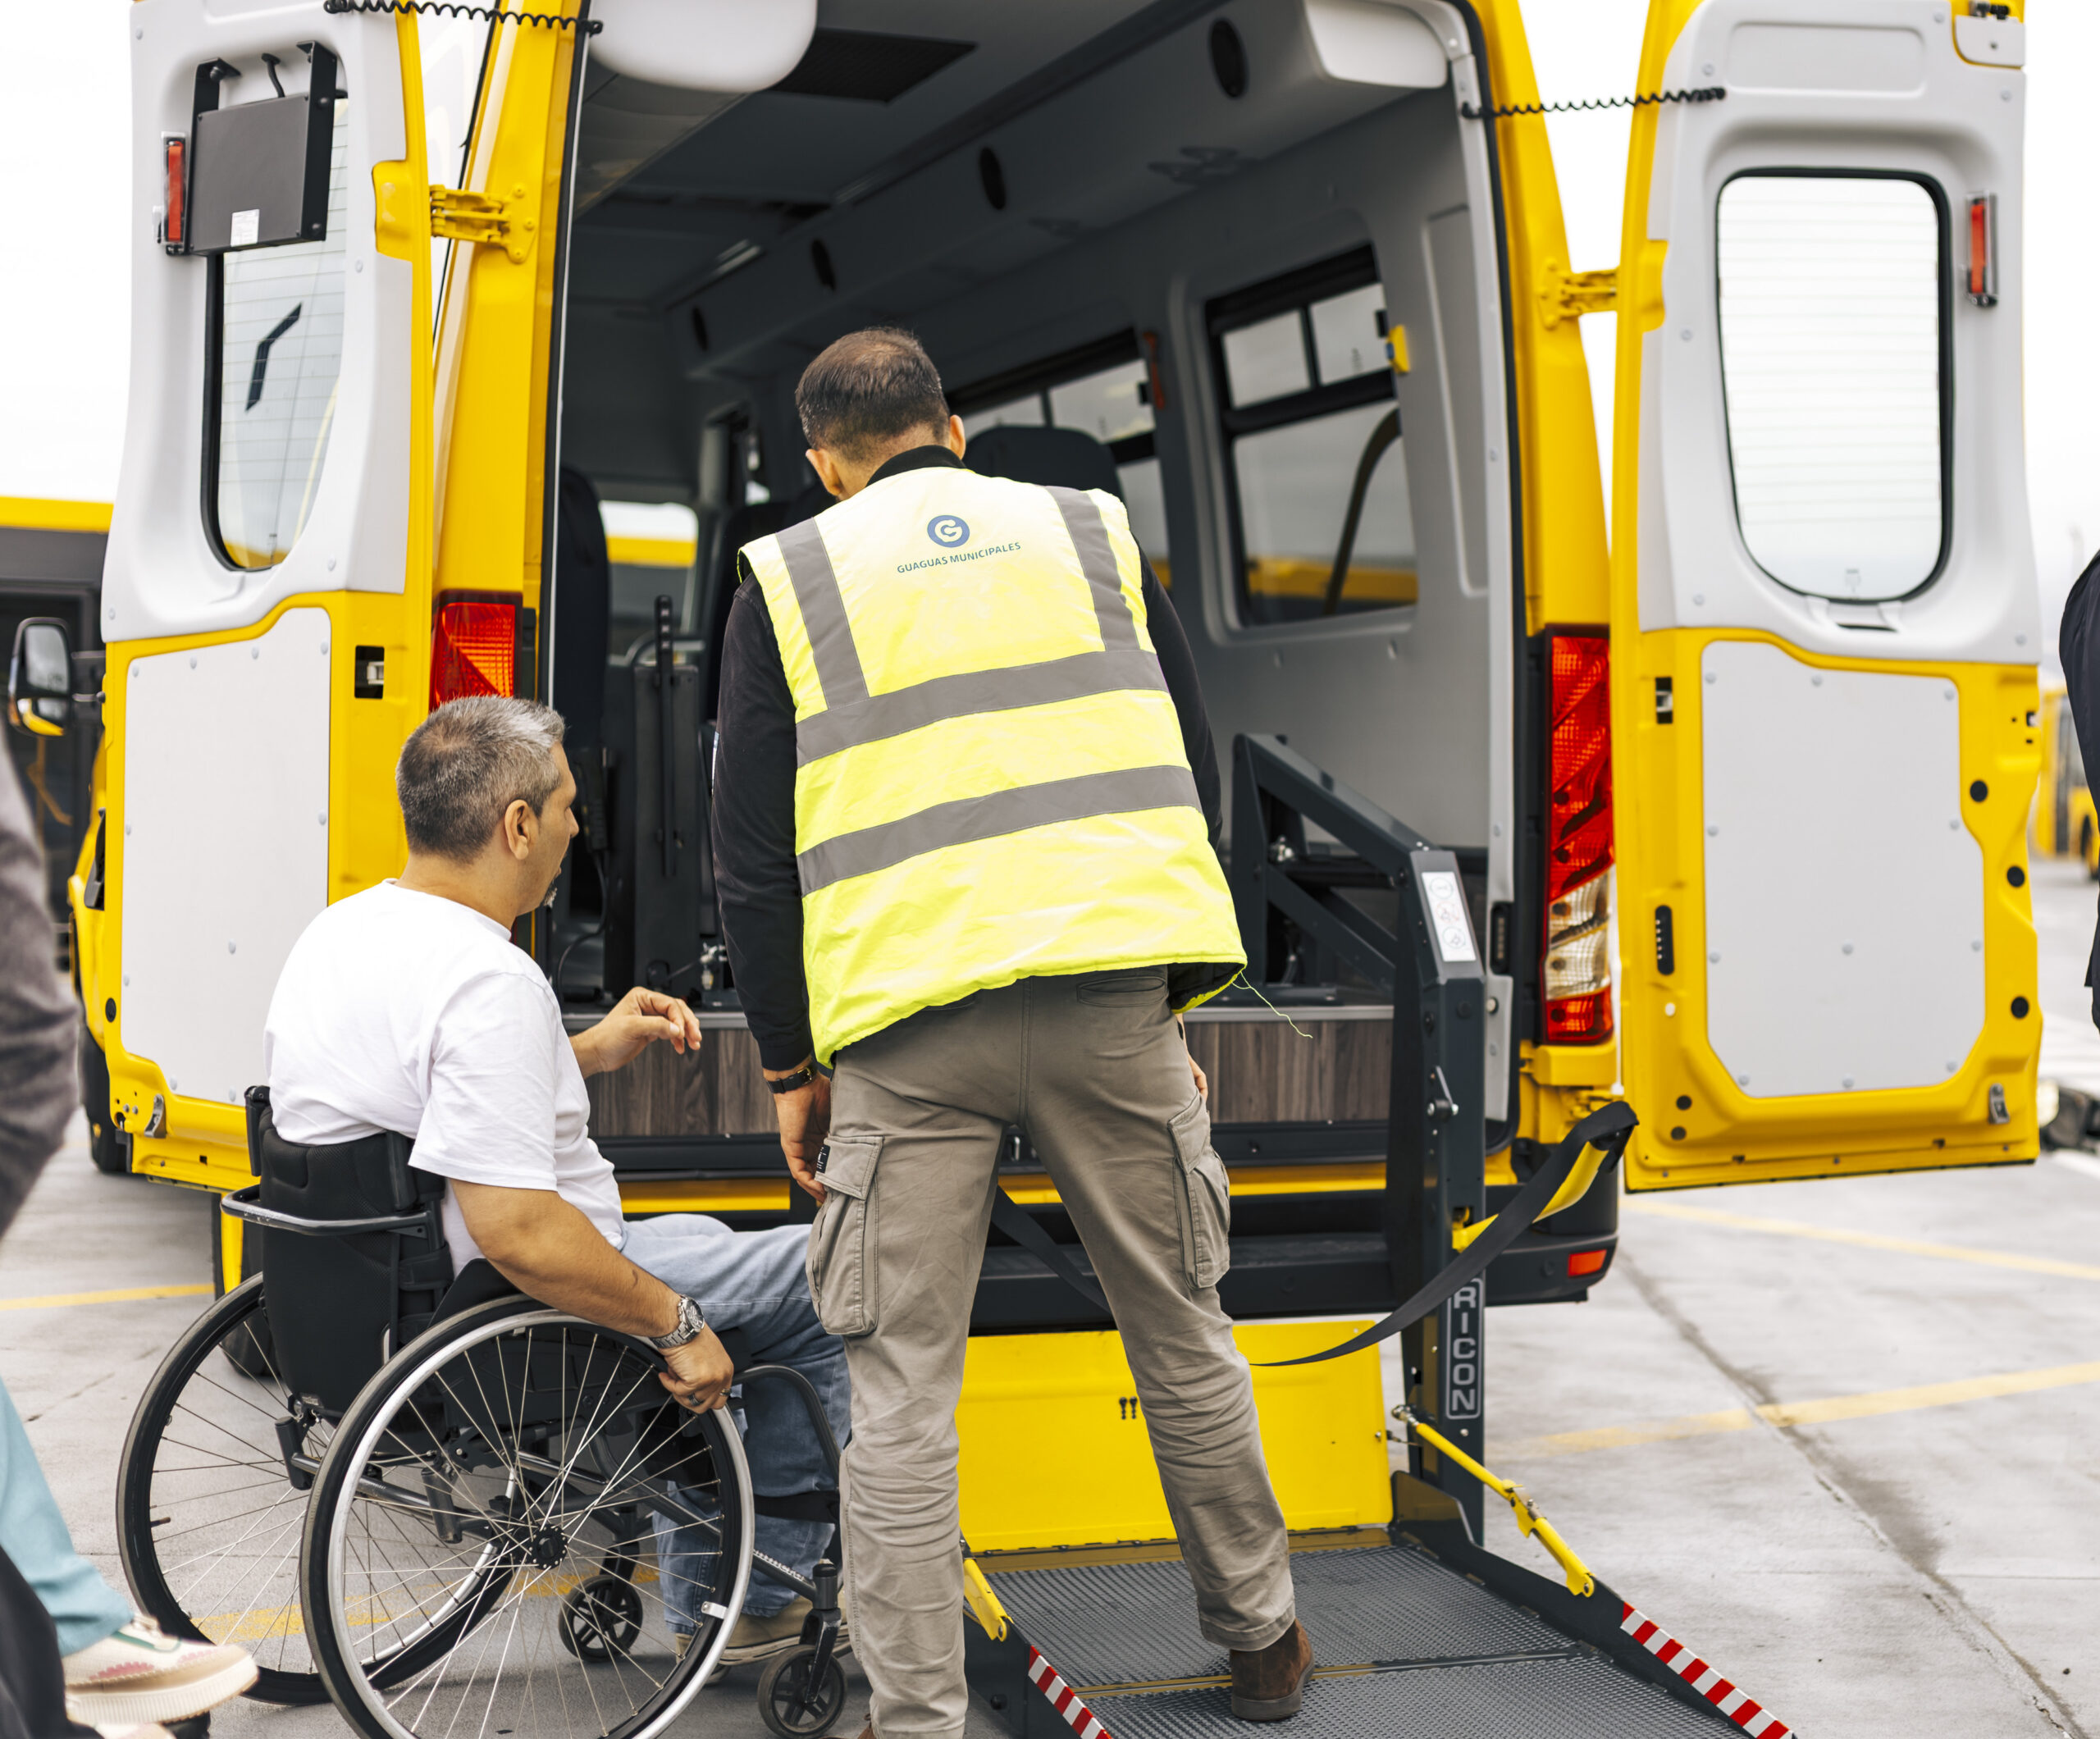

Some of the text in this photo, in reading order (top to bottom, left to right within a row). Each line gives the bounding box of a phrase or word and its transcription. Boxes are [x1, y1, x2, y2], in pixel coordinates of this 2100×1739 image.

[897, 542, 1021, 573] GUAGUAS MUNICIPALES
[1451, 1286, 1477, 1411] RICON
